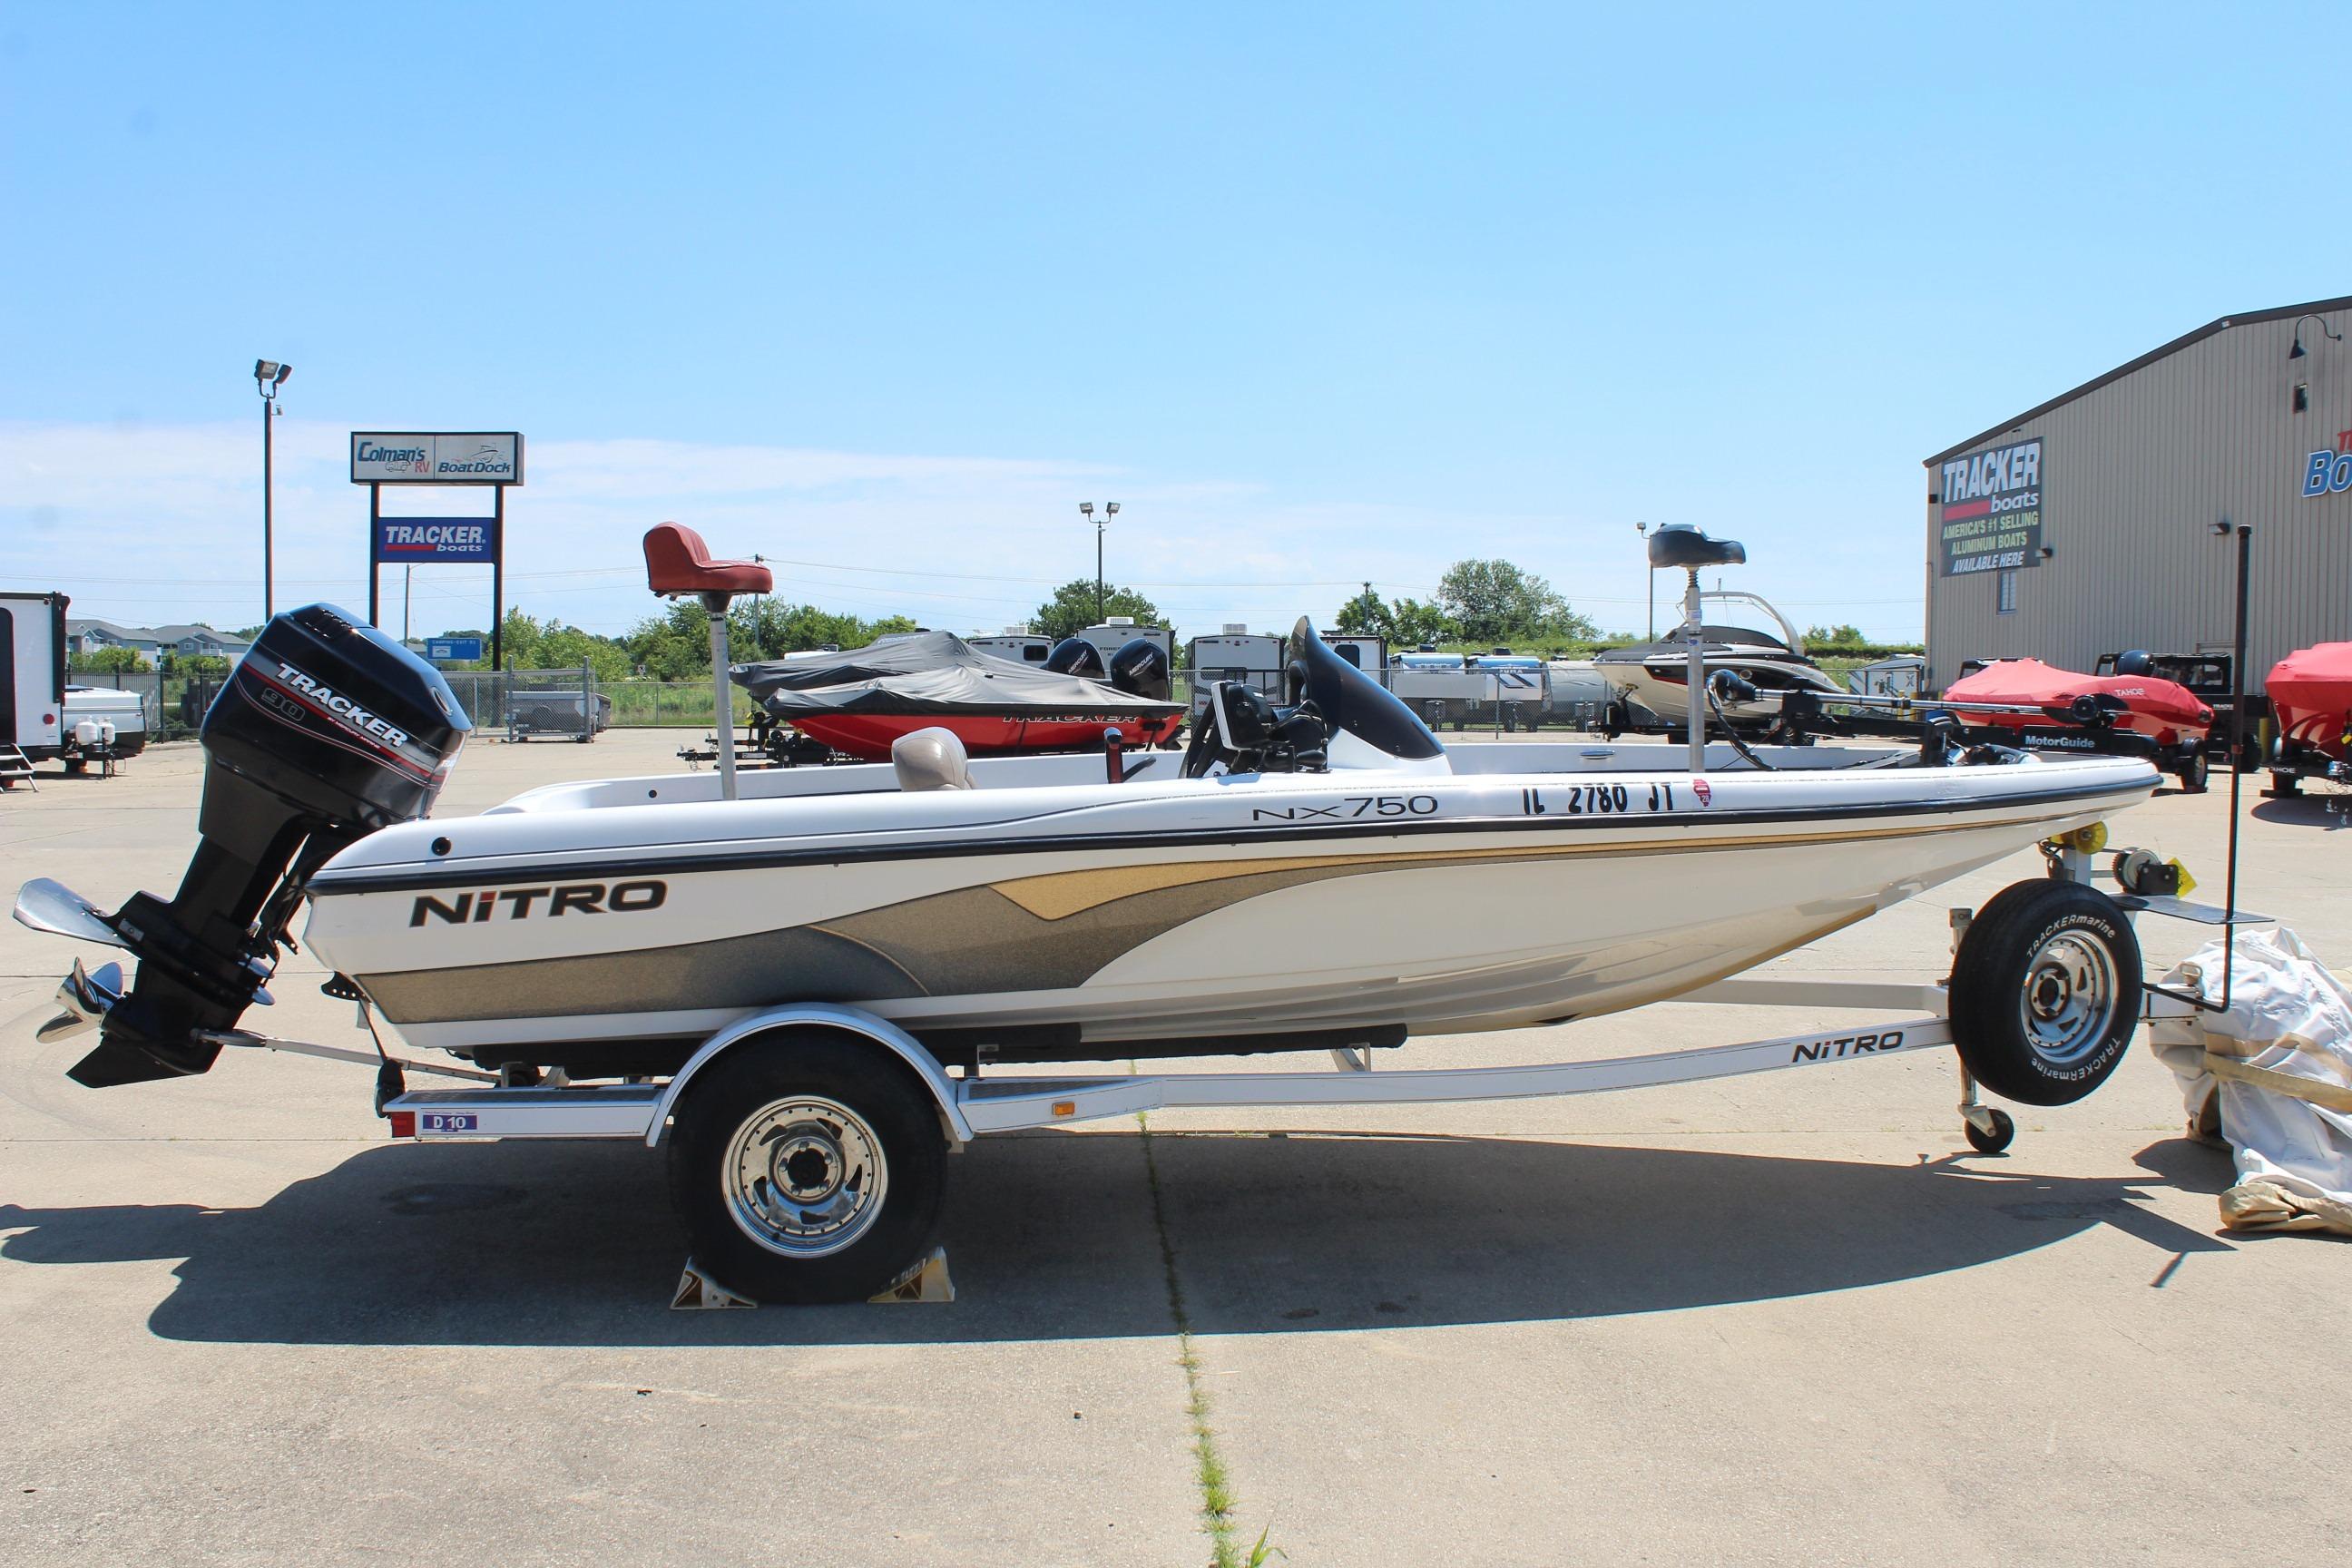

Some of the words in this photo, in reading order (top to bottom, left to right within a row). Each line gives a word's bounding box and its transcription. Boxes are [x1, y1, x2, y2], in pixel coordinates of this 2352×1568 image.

[358, 442, 426, 461] Colman's
[415, 461, 429, 473] RV
[1944, 443, 2040, 503] TRACKER
[1990, 492, 2038, 514] boats
[386, 526, 483, 544] TRACKER
[1943, 519, 1985, 540] AMERICA'S
[2000, 512, 2038, 530] SELLING
[1951, 536, 1995, 555] ALUMINUM
[1998, 532, 2027, 548] BOATS
[1953, 554, 1998, 573] AVAILABLE
[1999, 551, 2024, 567] HERE
[1129, 652, 1153, 676] MERCURY
[278, 663, 407, 747] TRACKER
[2025, 735, 2095, 748] MotorGuide
[1253, 796, 1438, 820] NX750
[1523, 788, 1545, 815] IL
[1568, 784, 1628, 813] 2780
[433, 1116, 443, 1128] D
[446, 1116, 466, 1128] 10
